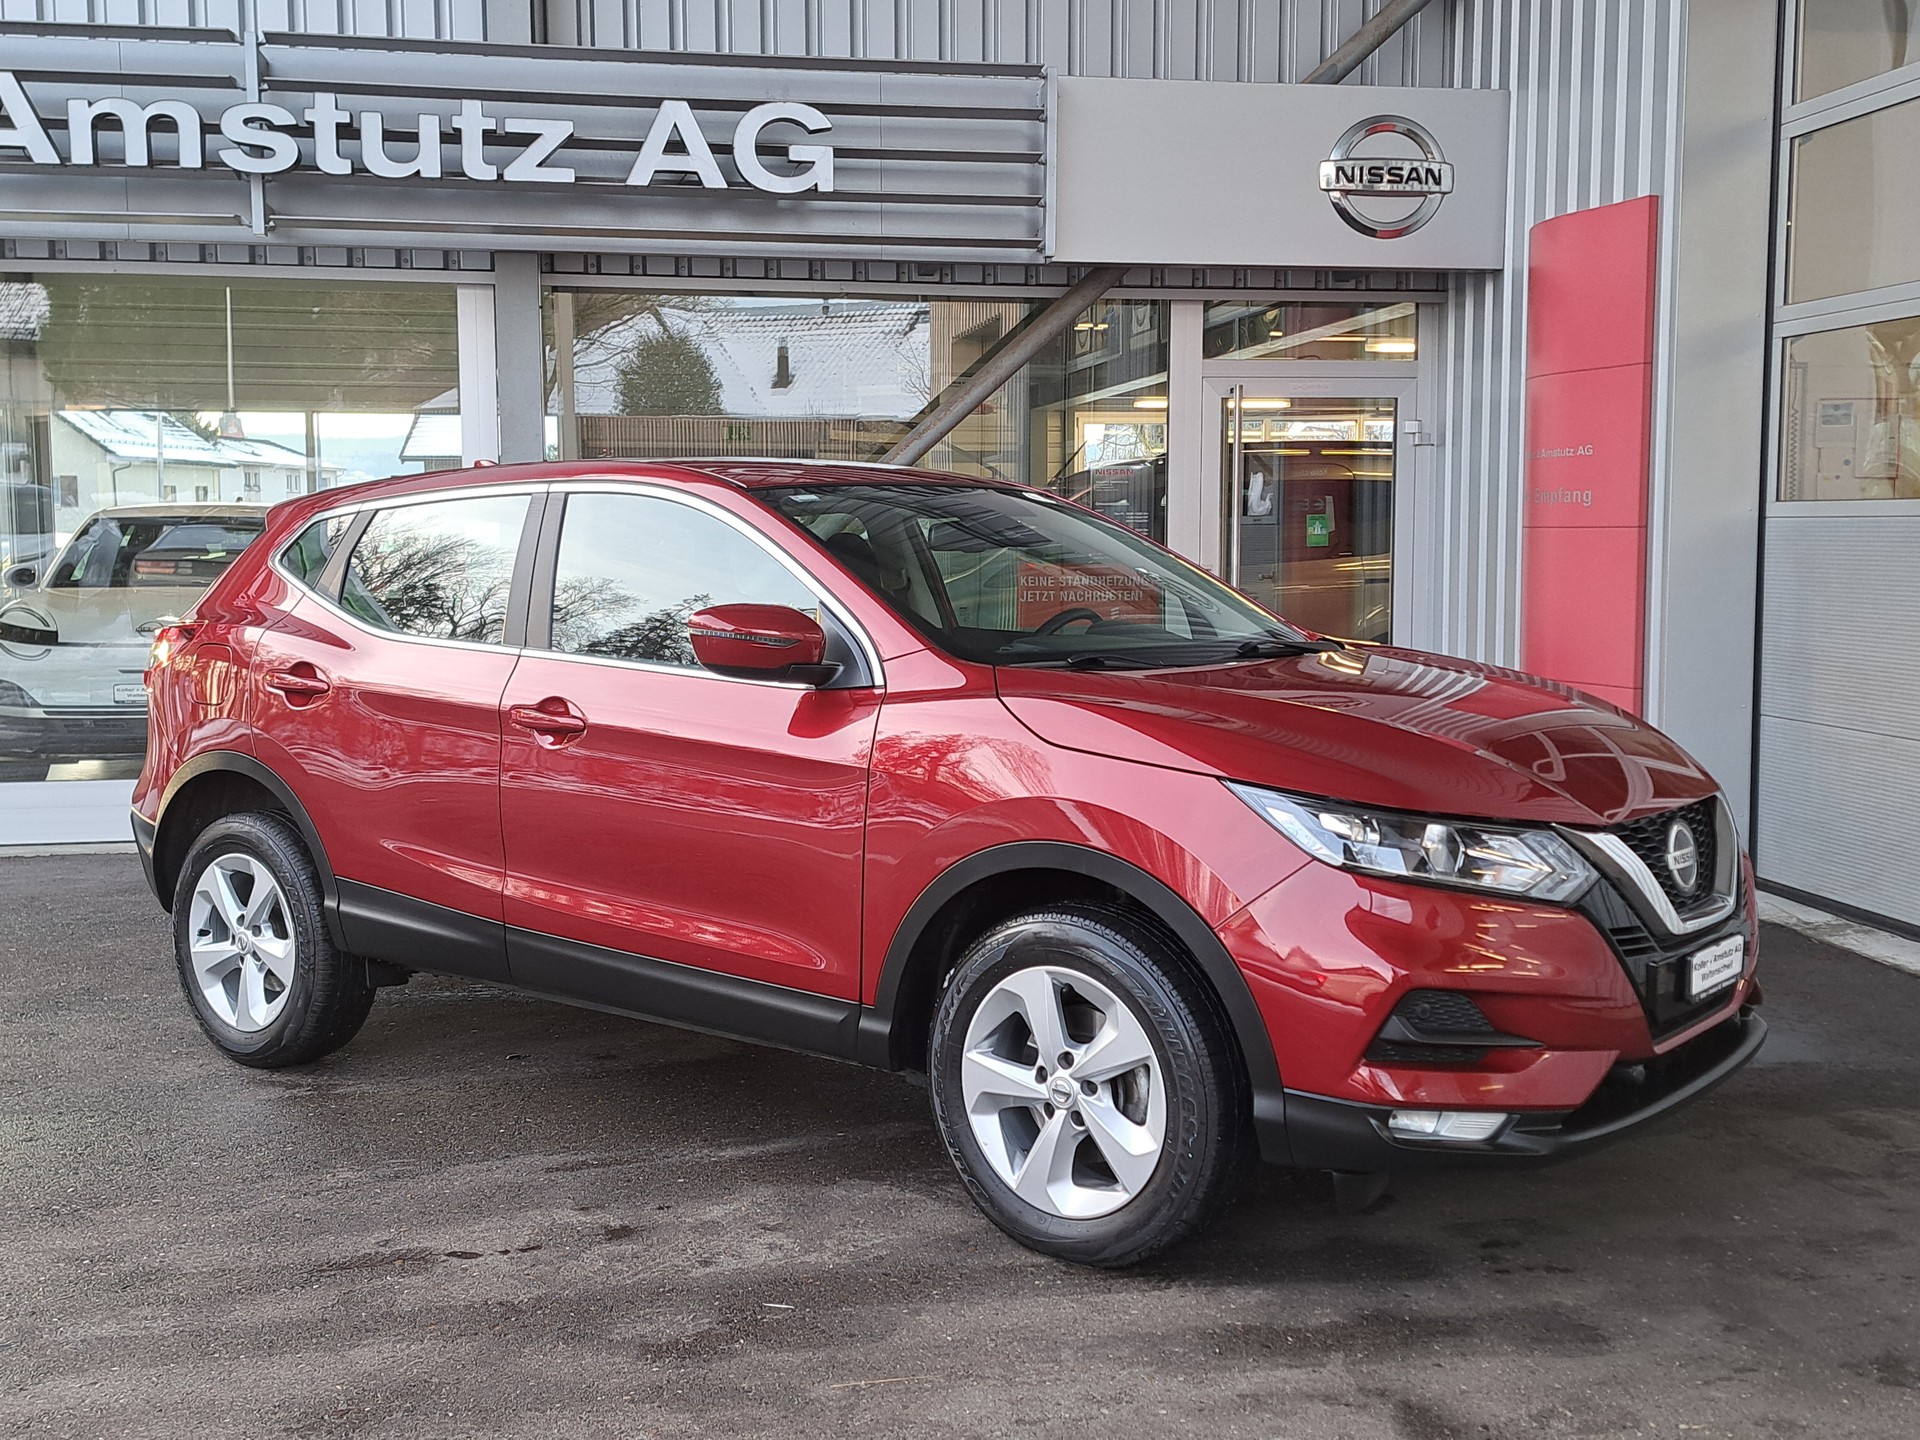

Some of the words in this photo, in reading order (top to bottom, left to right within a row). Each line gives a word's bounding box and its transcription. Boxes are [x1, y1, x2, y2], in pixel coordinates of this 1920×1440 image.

[0, 71, 577, 183] Amstutz
[625, 99, 834, 194] AG
[1334, 165, 1442, 187] NISSAN
[1576, 444, 1593, 456] AG
[1095, 468, 1134, 476] NISSAN
[1535, 487, 1592, 507] Empfang
[1020, 575, 1055, 587] KEINE
[1019, 590, 1055, 602] JETZT
